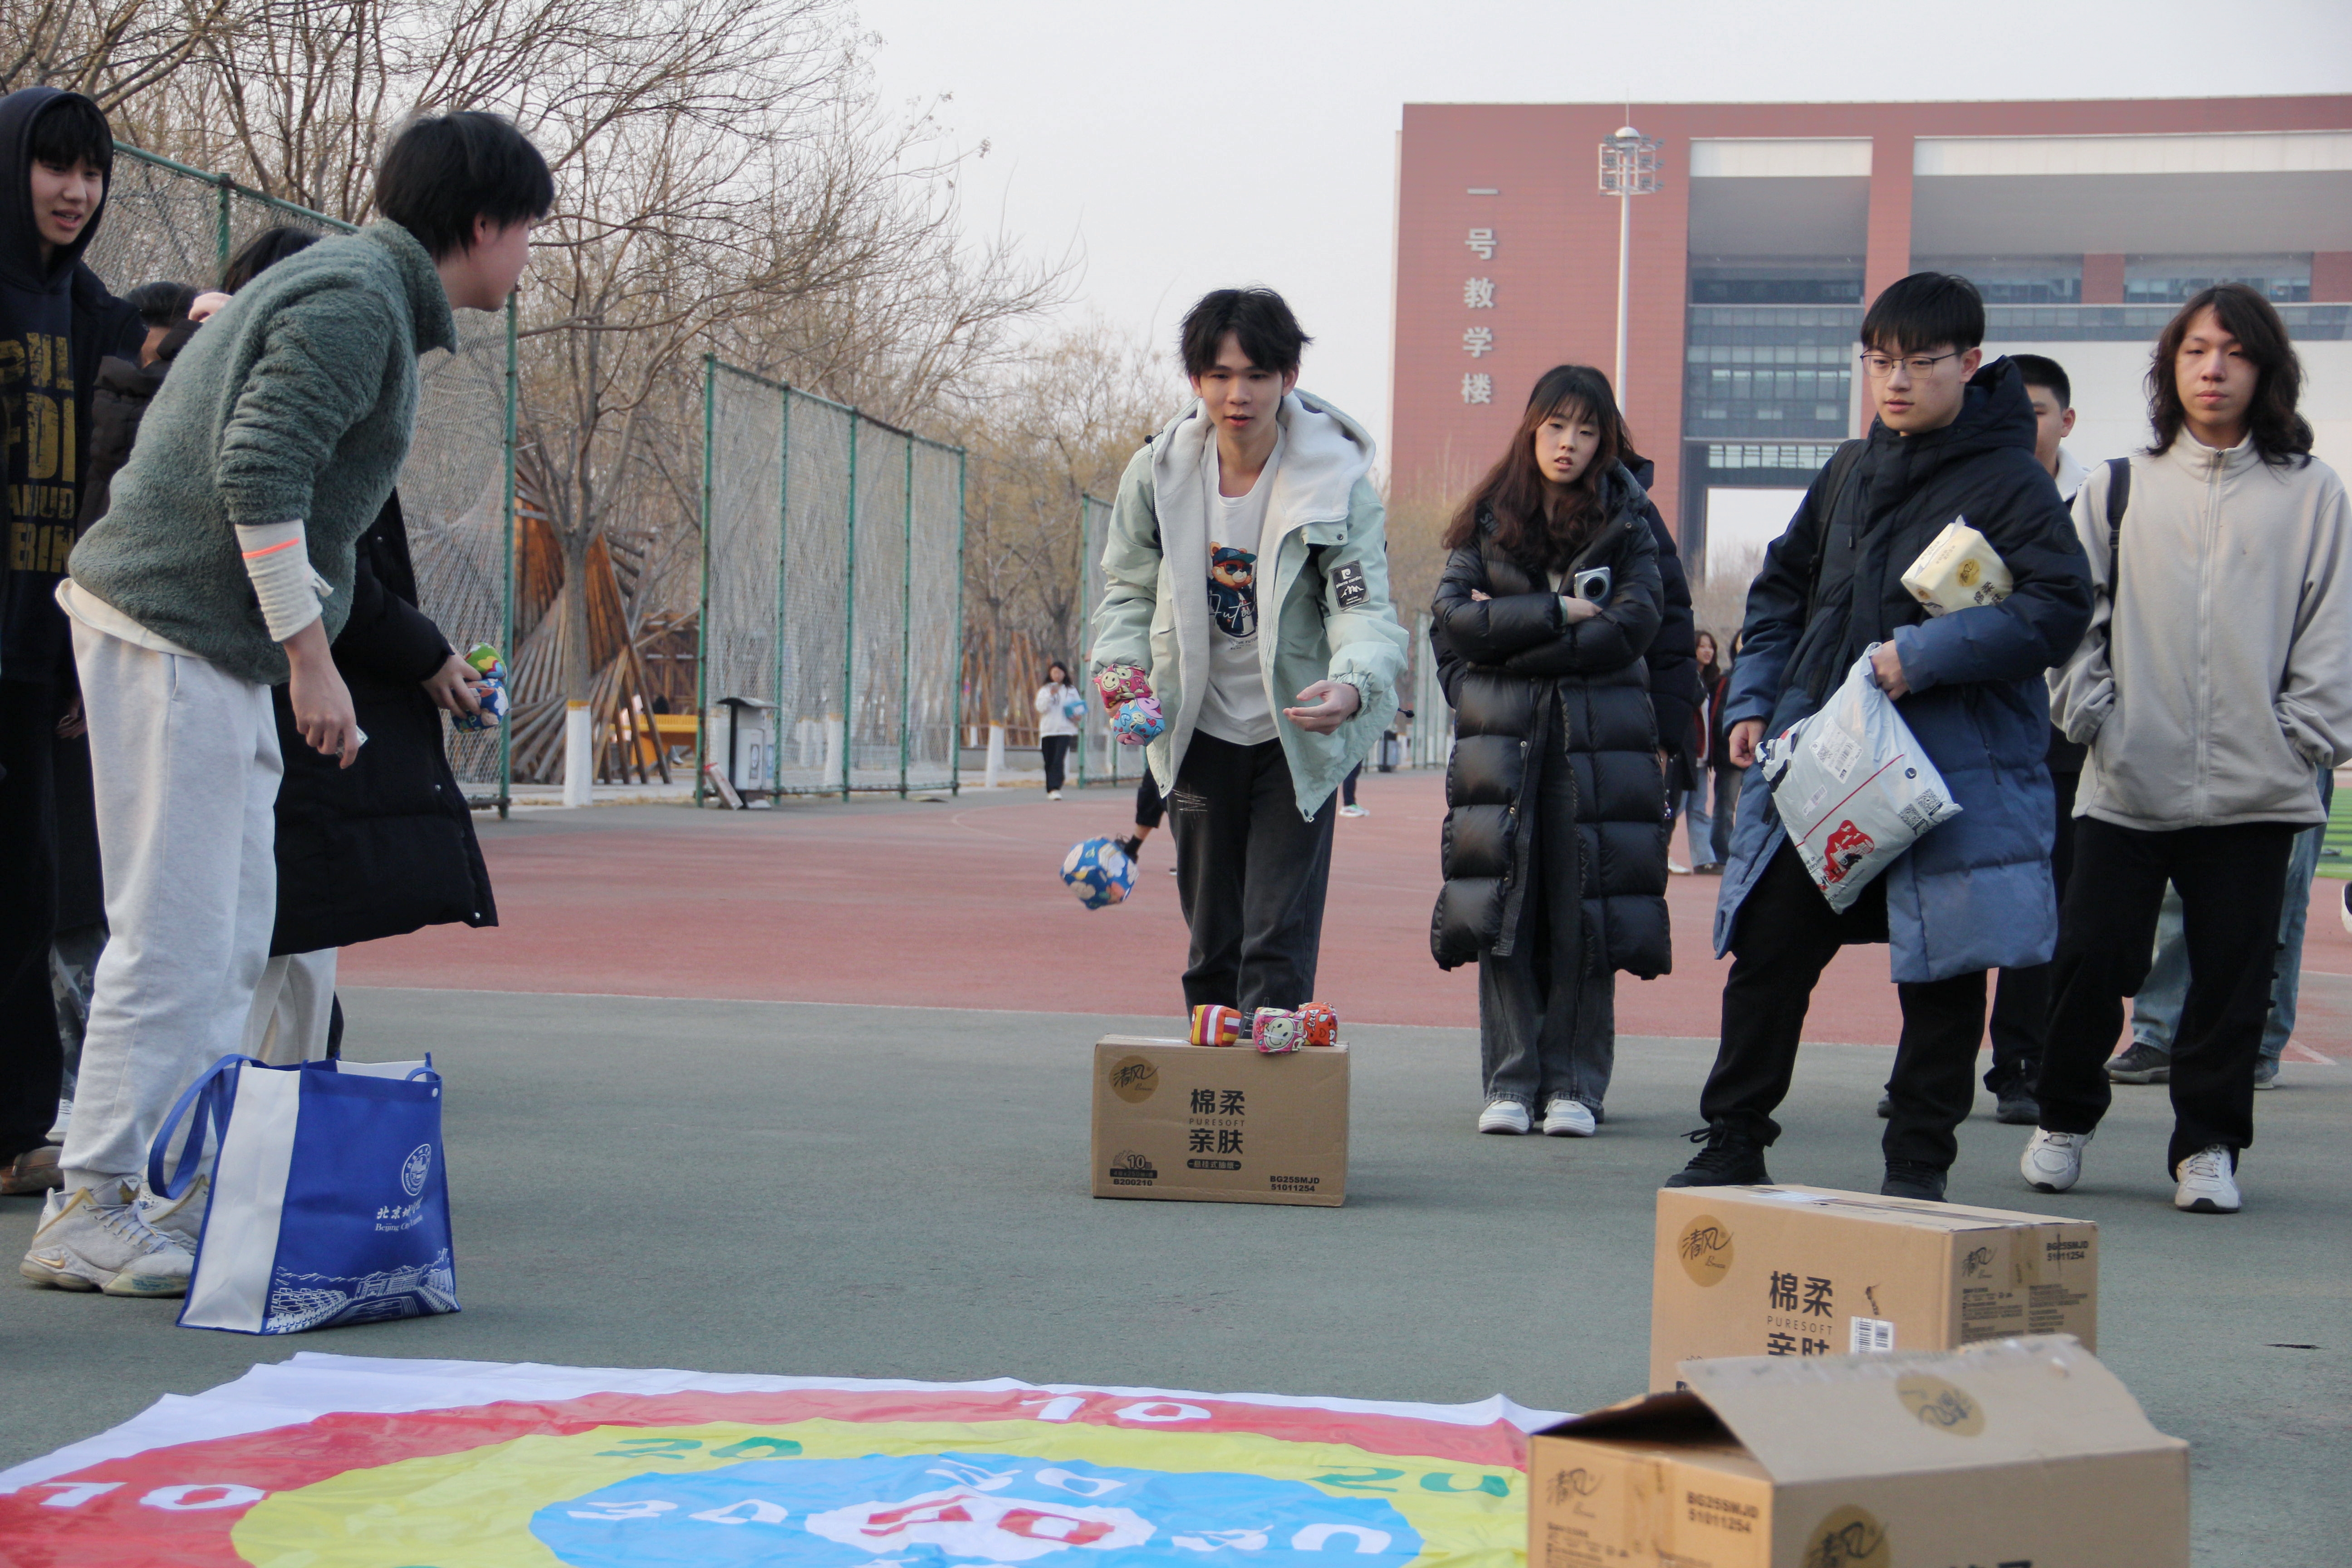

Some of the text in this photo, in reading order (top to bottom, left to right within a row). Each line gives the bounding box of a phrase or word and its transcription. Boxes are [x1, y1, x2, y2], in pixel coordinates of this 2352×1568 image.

[1461, 188, 1499, 404] 一号教学楼
[1336, 580, 1348, 589] pierre
[1113, 1064, 1159, 1088] 清风
[1191, 1089, 1245, 1116] 棉柔
[1189, 1118, 1245, 1127] PURESOFT
[1189, 1128, 1243, 1154] 亲肤
[1127, 1154, 1146, 1169] 10
[1270, 1176, 1319, 1184] BG25SMJD
[375, 1223, 400, 1232] Beijing
[1682, 1227, 1734, 1260] 清风
[2047, 1240, 2089, 1251] BG25SMJD
[2047, 1251, 2085, 1261] 51011254
[1769, 1271, 1833, 1318] 棉柔
[1767, 1316, 1833, 1335] PURESOFT
[1020, 1396, 1211, 1422] 10
[594, 1436, 803, 1460] 20
[1308, 1465, 1510, 1498] 20
[39, 1482, 268, 1510] 10
[1686, 1490, 1759, 1518] BG25SMJD
[567, 1499, 787, 1524] 30
[1689, 1508, 1752, 1534] 51011254
